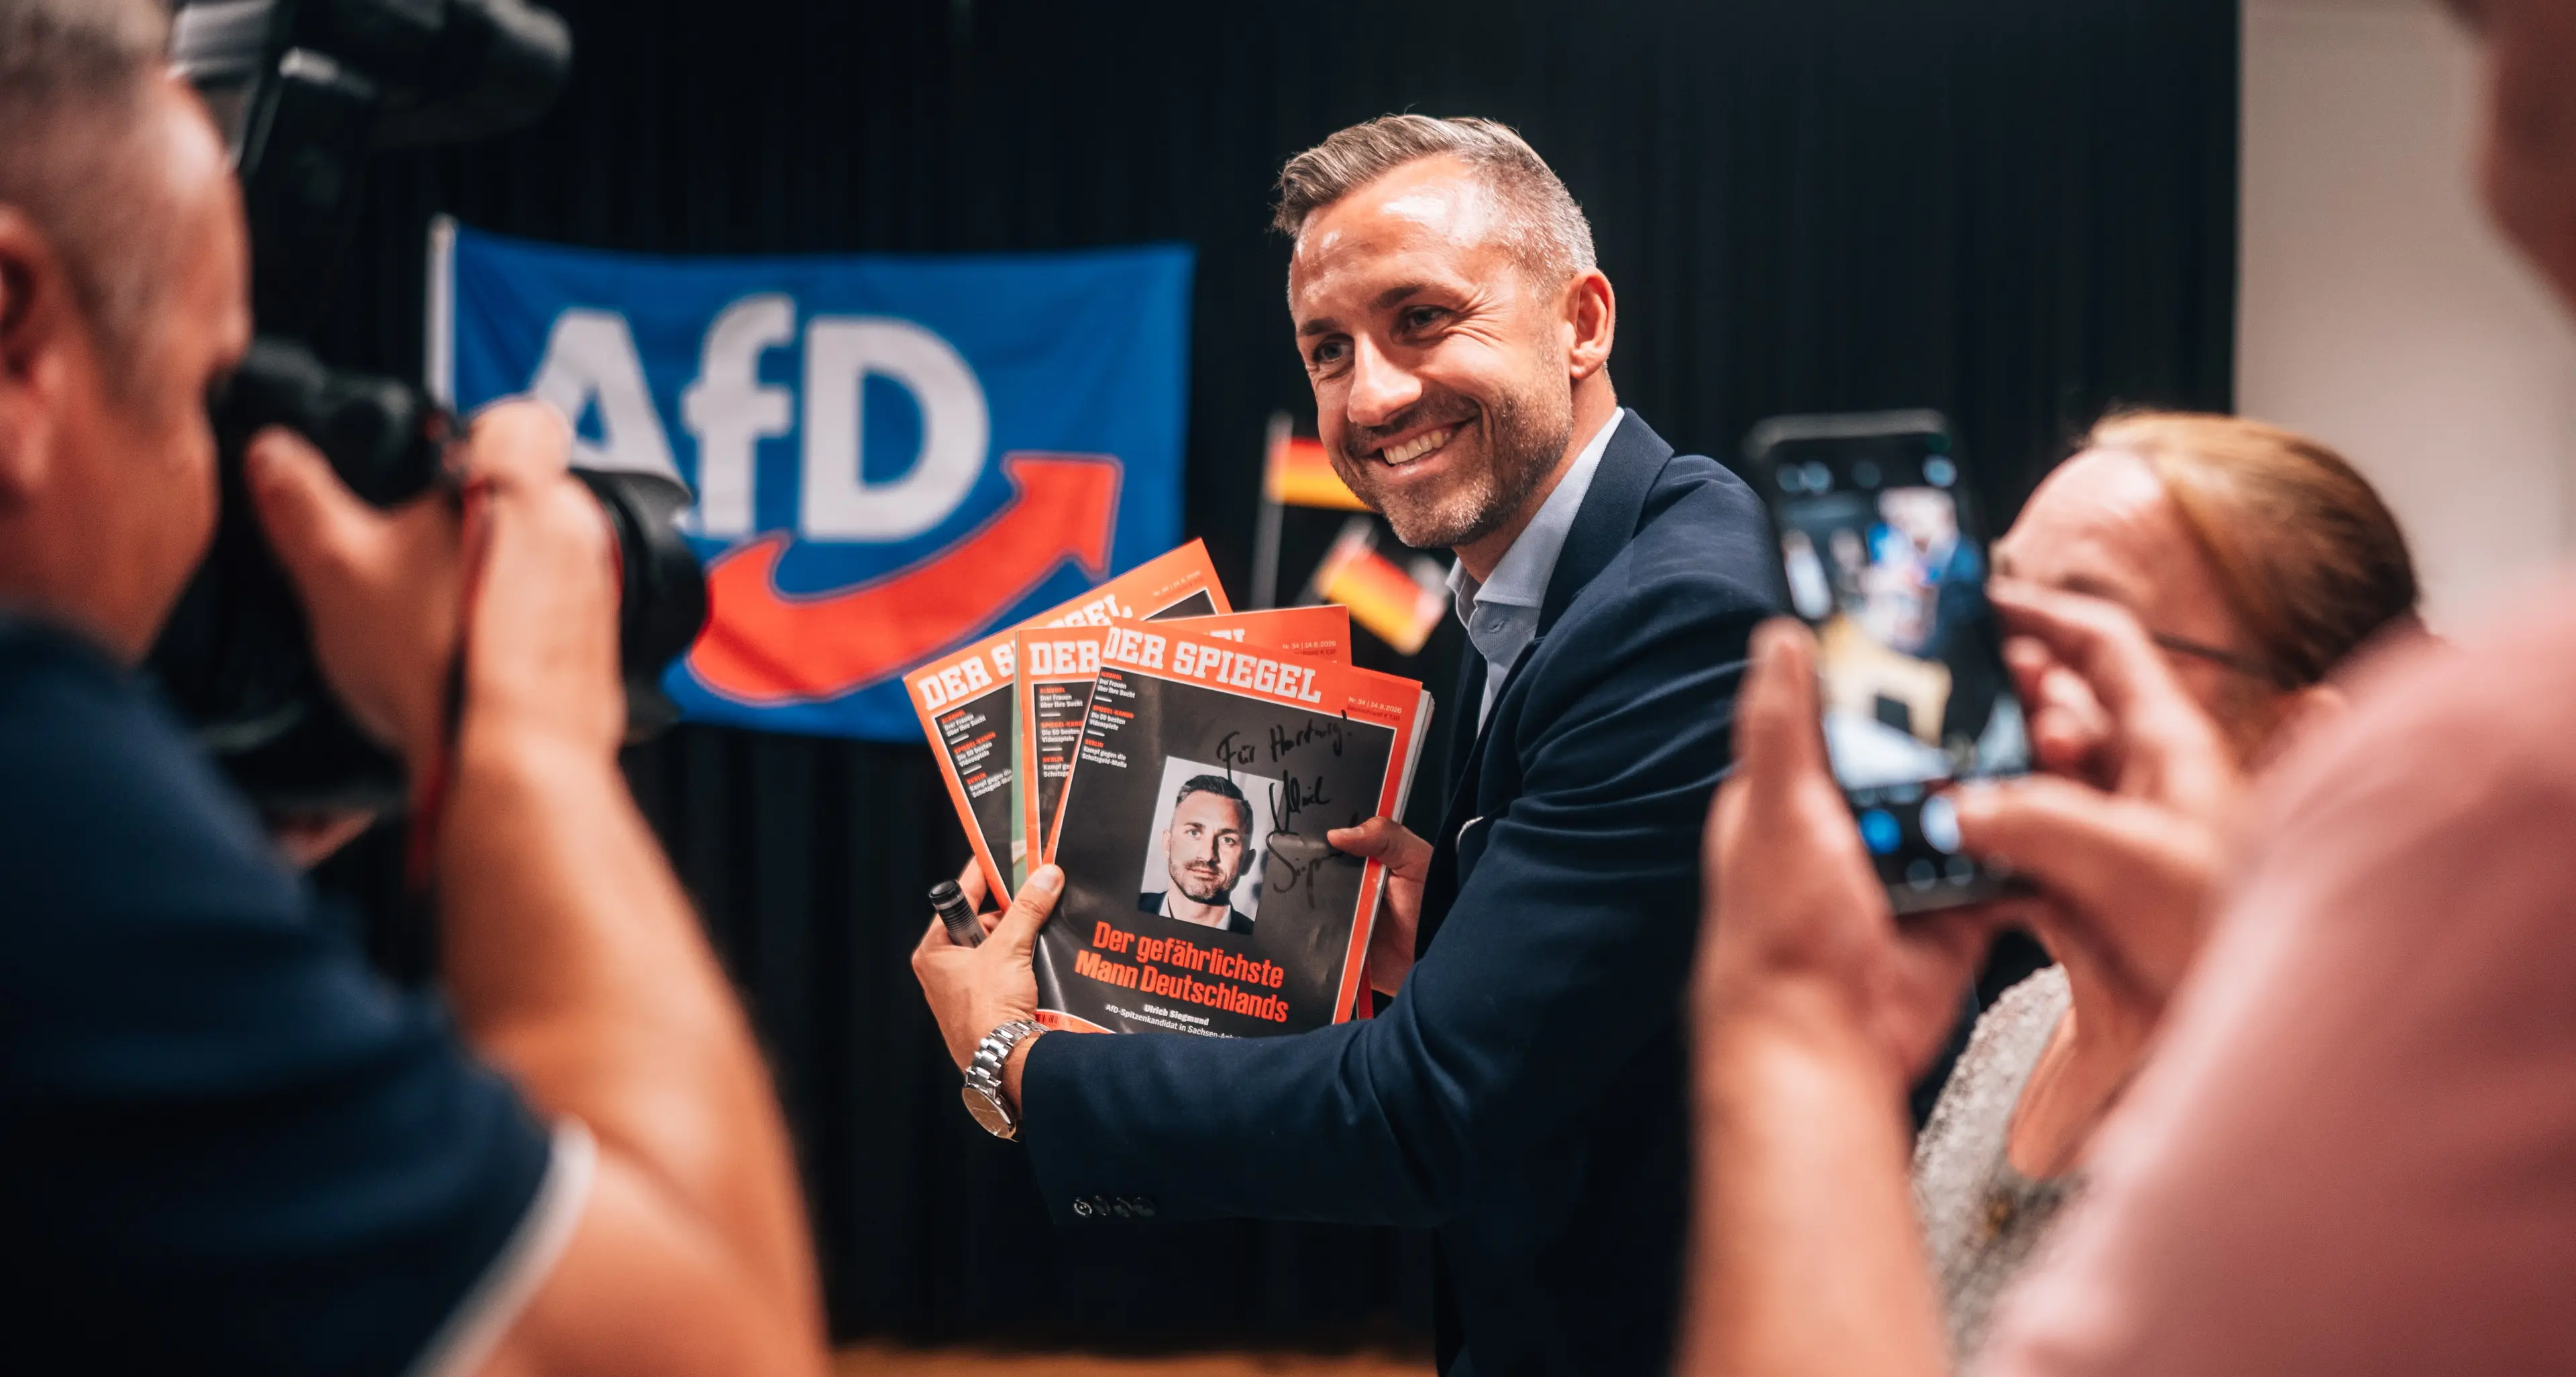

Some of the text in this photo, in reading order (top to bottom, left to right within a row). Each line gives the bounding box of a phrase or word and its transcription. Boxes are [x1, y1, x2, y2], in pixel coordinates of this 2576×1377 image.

[530, 293, 992, 542] AfD
[1029, 641, 1100, 675] DER
[1103, 626, 1322, 704] DER SPIEGEL
[917, 656, 993, 711] DER
[1101, 671, 1122, 681] ALKOHOL
[1108, 680, 1127, 690] Frauen
[1120, 690, 1135, 699] Sucht
[1092, 705, 1134, 719] SPIEGEL-KANON
[1371, 702, 1402, 714] 14.8.2026
[1089, 719, 1119, 730] Videospiele
[1107, 715, 1126, 724] besten
[1042, 735, 1075, 743] Videospiele
[1085, 738, 1104, 748] BERLIN
[974, 740, 993, 754] besten
[1083, 746, 1126, 761] Kampf gegen die
[959, 750, 990, 767] Videospiele
[1081, 753, 1127, 769] Schutzgeld-Mafia
[1216, 730, 1256, 783] Für
[1093, 920, 1284, 989] Der gefährlichste
[1075, 949, 1289, 1023] Mann Deutschlands
[1106, 1004, 1178, 1030] AfD-Spitzenkandidat
[1179, 1024, 1186, 1032] in
[1144, 1004, 1209, 1026] Ulrich Siegmund
